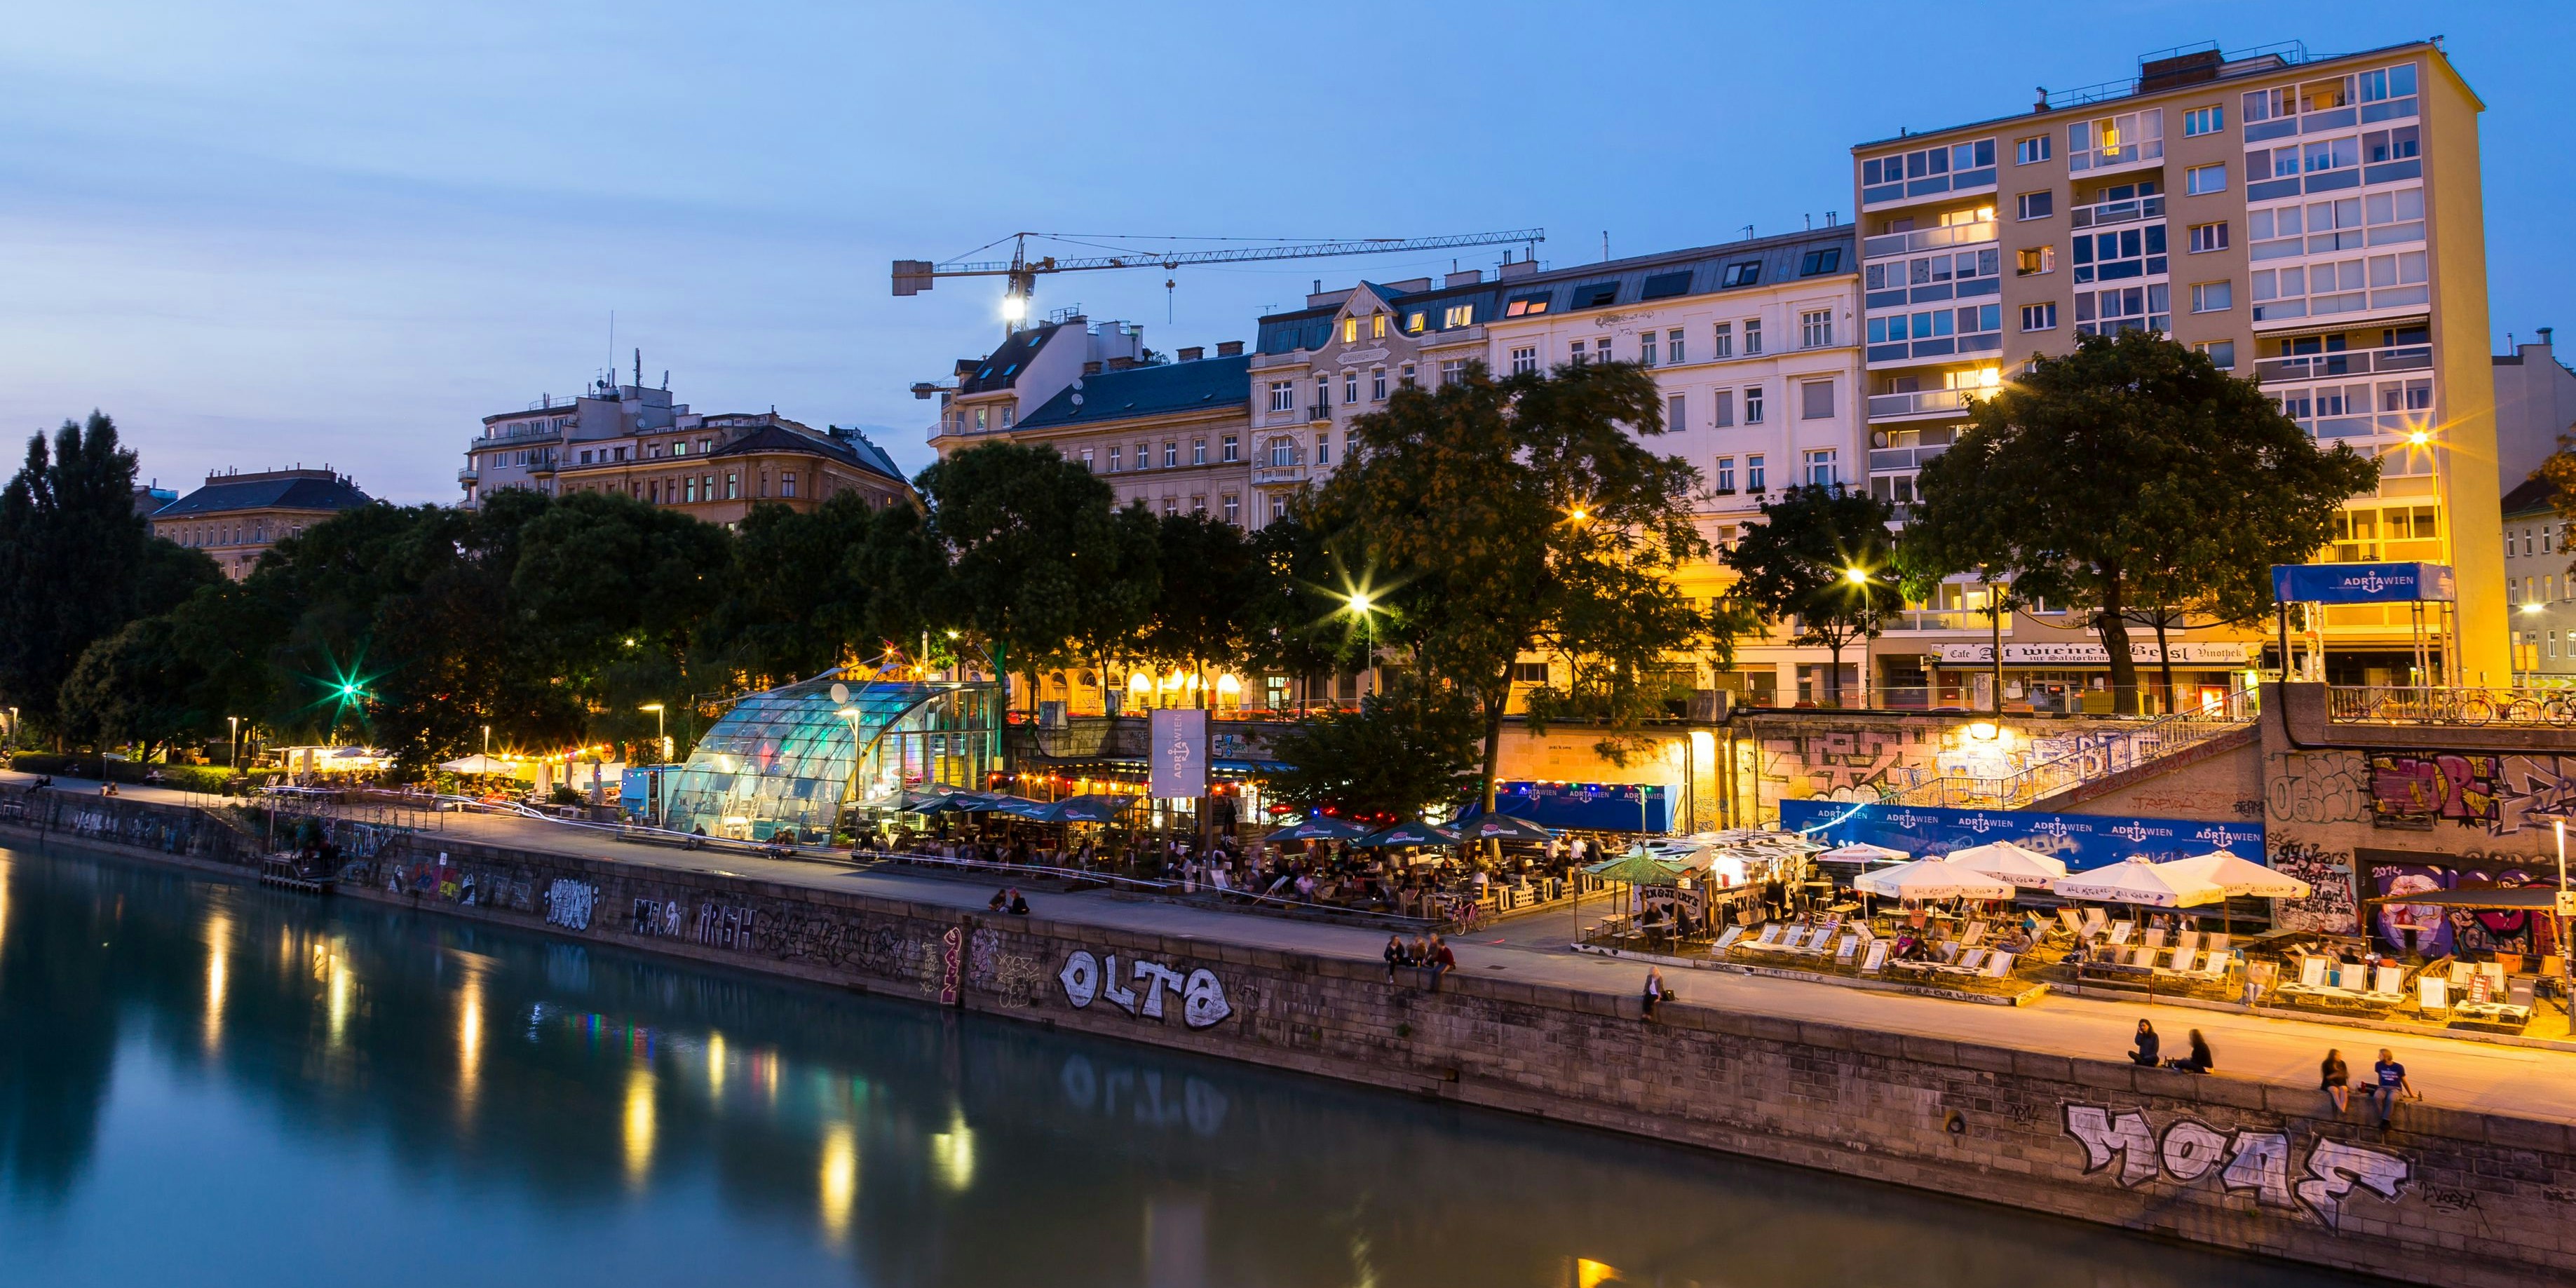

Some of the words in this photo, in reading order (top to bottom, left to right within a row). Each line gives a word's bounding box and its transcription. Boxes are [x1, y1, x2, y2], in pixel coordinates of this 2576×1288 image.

[1950, 650, 1970, 658] Cafe
[1979, 647, 2012, 660] At
[2129, 645, 2188, 660] Besl
[2197, 649, 2242, 658] Vinothek
[2372, 866, 2402, 878] 2014
